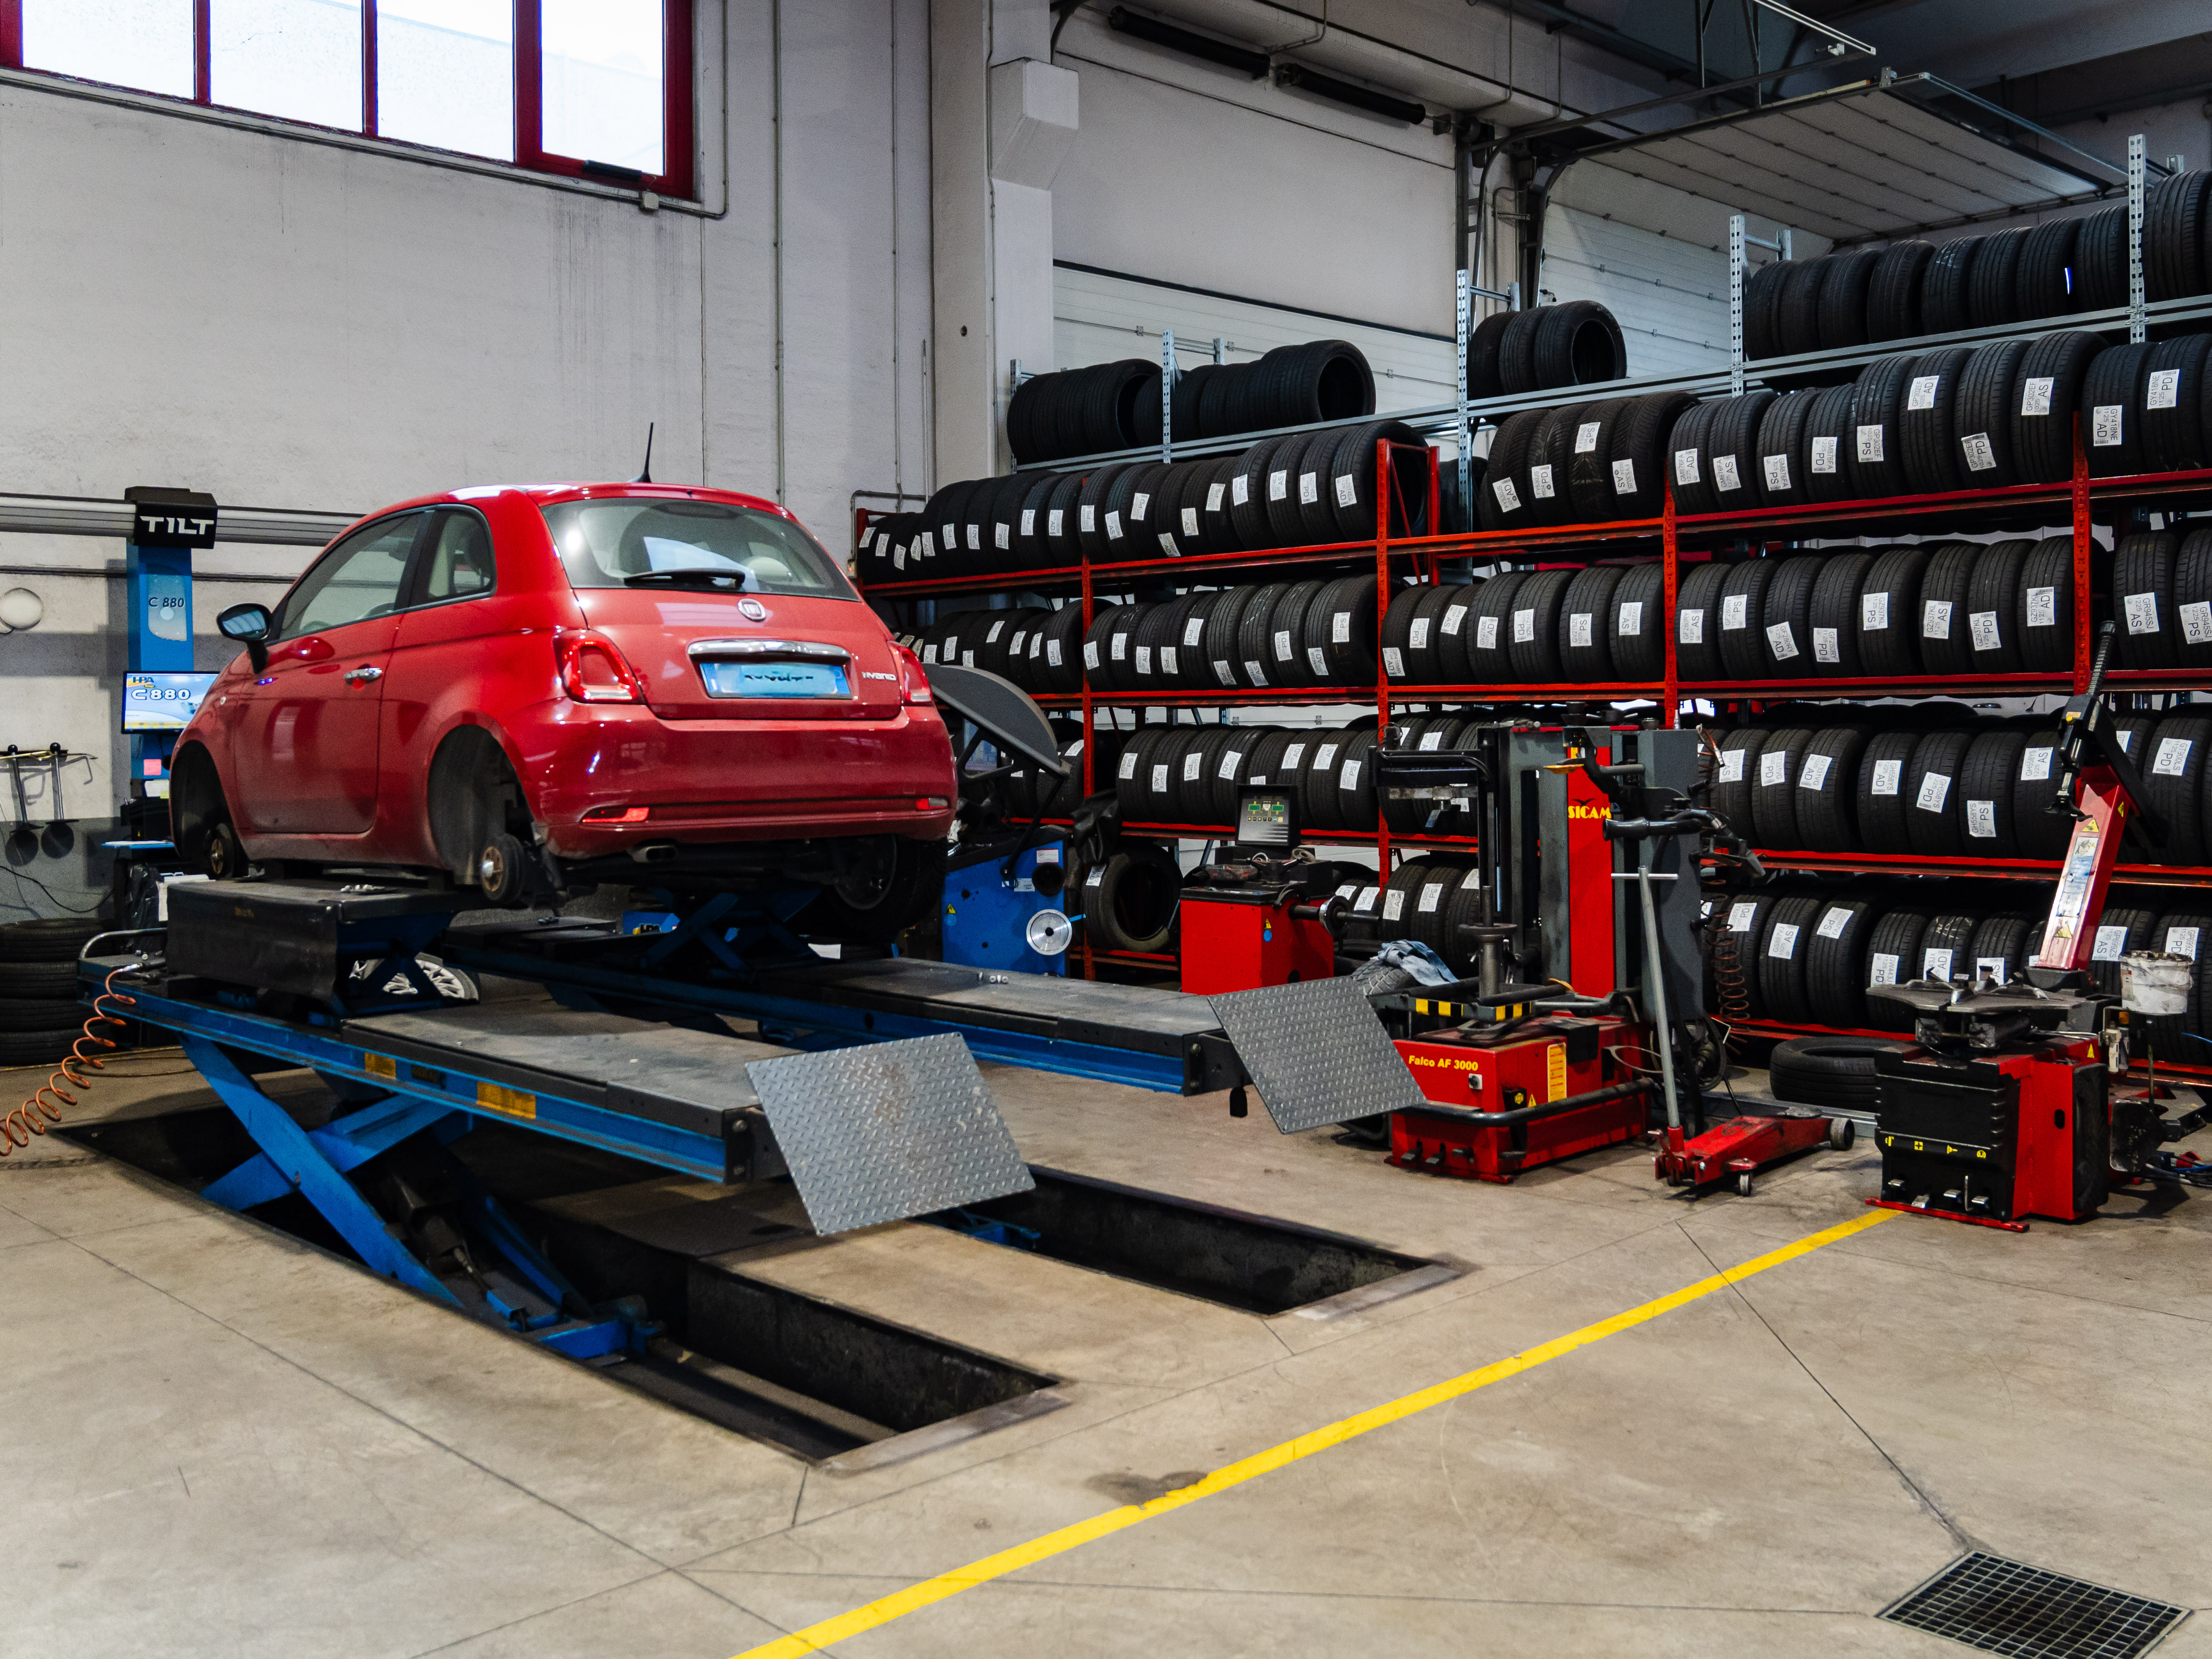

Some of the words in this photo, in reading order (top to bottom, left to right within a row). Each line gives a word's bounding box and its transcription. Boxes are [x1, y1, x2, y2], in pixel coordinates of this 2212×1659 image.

[1923, 382, 1934, 394] AD
[2162, 377, 2172, 390] PD
[1912, 380, 1922, 406] GP302EF
[2025, 381, 2036, 410] GP302EF
[2038, 384, 2048, 397] AS
[2149, 375, 2159, 405] GY418NE
[1586, 427, 1595, 438] PS
[2097, 423, 2106, 437] AD
[1862, 442, 1871, 455] PS
[1975, 440, 1986, 454] PD
[1686, 456, 1694, 469] AD
[1816, 453, 1824, 465] PD
[1977, 455, 1985, 468] 1025
[1714, 459, 1728, 488] GM876FA
[1725, 461, 1734, 474] AS
[1778, 458, 1788, 487] GM876FA
[1278, 475, 1284, 486] AS
[1541, 471, 1549, 483] PD
[1616, 475, 1625, 488] AS
[1623, 464, 1633, 489] FY530JS
[1769, 472, 1778, 484] PS
[1239, 480, 1244, 490] PS
[1345, 477, 1353, 501] GZ074ES
[1503, 484, 1513, 497] AD
[1214, 488, 1220, 497] PS
[1303, 486, 1309, 497] PD
[1339, 489, 1346, 501] AD
[1138, 499, 1144, 508] PD
[1026, 515, 1031, 524] PD
[1086, 510, 1091, 519] PS
[140, 516, 214, 535] TILT
[1050, 521, 1055, 530] AD
[1109, 524, 1115, 534] AS
[1183, 521, 1190, 530] AS
[972, 529, 976, 539] AD
[998, 533, 1002, 543] PD
[149, 597, 159, 607] C
[162, 597, 184, 608] 880
[1734, 601, 1741, 612] PS
[2041, 595, 2050, 609] AD
[1630, 606, 1639, 631] GV278ZE
[1867, 610, 1875, 623] PS
[1926, 604, 1936, 633] GZ937KL
[1937, 608, 1947, 621] AS
[2142, 597, 2153, 629] GR945SJ
[1340, 618, 1346, 628] PS
[1443, 616, 1452, 627] AS
[1579, 620, 1587, 630] PS
[1621, 617, 1629, 629] AS
[1691, 615, 1699, 627] AS
[2130, 613, 2142, 627] AS
[2199, 605, 2212, 639] GR945SJ
[1487, 623, 1494, 635] AD
[1518, 623, 1524, 635] PD
[1972, 618, 1984, 647] GZ937KL
[1982, 620, 1993, 633] PD
[2188, 621, 2199, 637] PS
[1186, 629, 1193, 639] PD
[1412, 631, 1419, 641] PD
[1779, 625, 1794, 653] GF280RY
[1281, 637, 1287, 647] PD
[1773, 639, 1784, 653] AD
[1828, 631, 1836, 658] GF280RY
[946, 647, 950, 656] AD
[1114, 645, 1119, 654] PD
[1818, 643, 1827, 655] PD
[1050, 651, 1054, 660] PD
[1087, 654, 1092, 664] PS
[1142, 652, 1147, 662] AD
[1315, 653, 1323, 664] AD
[1164, 659, 1169, 668] PS
[1387, 661, 1394, 670] AD
[1253, 665, 1261, 675] AS
[132, 689, 147, 700] C
[150, 688, 191, 700] 880
[1292, 748, 1301, 757] AD
[1325, 748, 1334, 757] AS
[2037, 752, 2048, 763] AS
[2171, 743, 2188, 770] GT900LS
[1126, 758, 1133, 766] PS
[2026, 750, 2035, 775] GH558YS
[2159, 752, 2173, 766] PD
[1187, 764, 1192, 774] PD
[1222, 761, 1229, 772] AD
[1349, 766, 1356, 776] PS
[1721, 765, 1730, 775] AS
[1765, 765, 1773, 779] PD
[1812, 758, 1827, 786] GT331VG
[1804, 767, 1815, 780] AD
[1887, 763, 1897, 790] GH558YS
[1154, 777, 1159, 786] AS
[1875, 774, 1885, 786] AD
[1922, 788, 1934, 802] PD
[1932, 778, 1947, 808] GH558YS
[1568, 806, 1611, 819] SICAM
[1969, 803, 1979, 832] GH558YS
[1979, 808, 1989, 820] PS
[1429, 889, 1437, 898] PS
[1358, 897, 1366, 905] PS
[1739, 908, 1750, 917] PD
[1823, 919, 1835, 930] PS
[1772, 926, 1785, 952] GS887VJ
[1783, 930, 1794, 943] AS
[2105, 928, 2113, 940] 1125
[2179, 928, 2187, 939] 1125
[2096, 941, 2108, 953] AS
[2108, 930, 2121, 957] GP699ZS
[2170, 941, 2183, 953] PD
[2183, 930, 2195, 955] GP699ZS
[1938, 956, 1948, 969] AD
[1875, 969, 1884, 982] PD
[1408, 1055, 1435, 1068] Falco
[1437, 1058, 1451, 1069] AF
[1454, 1059, 1479, 1071] 3000
